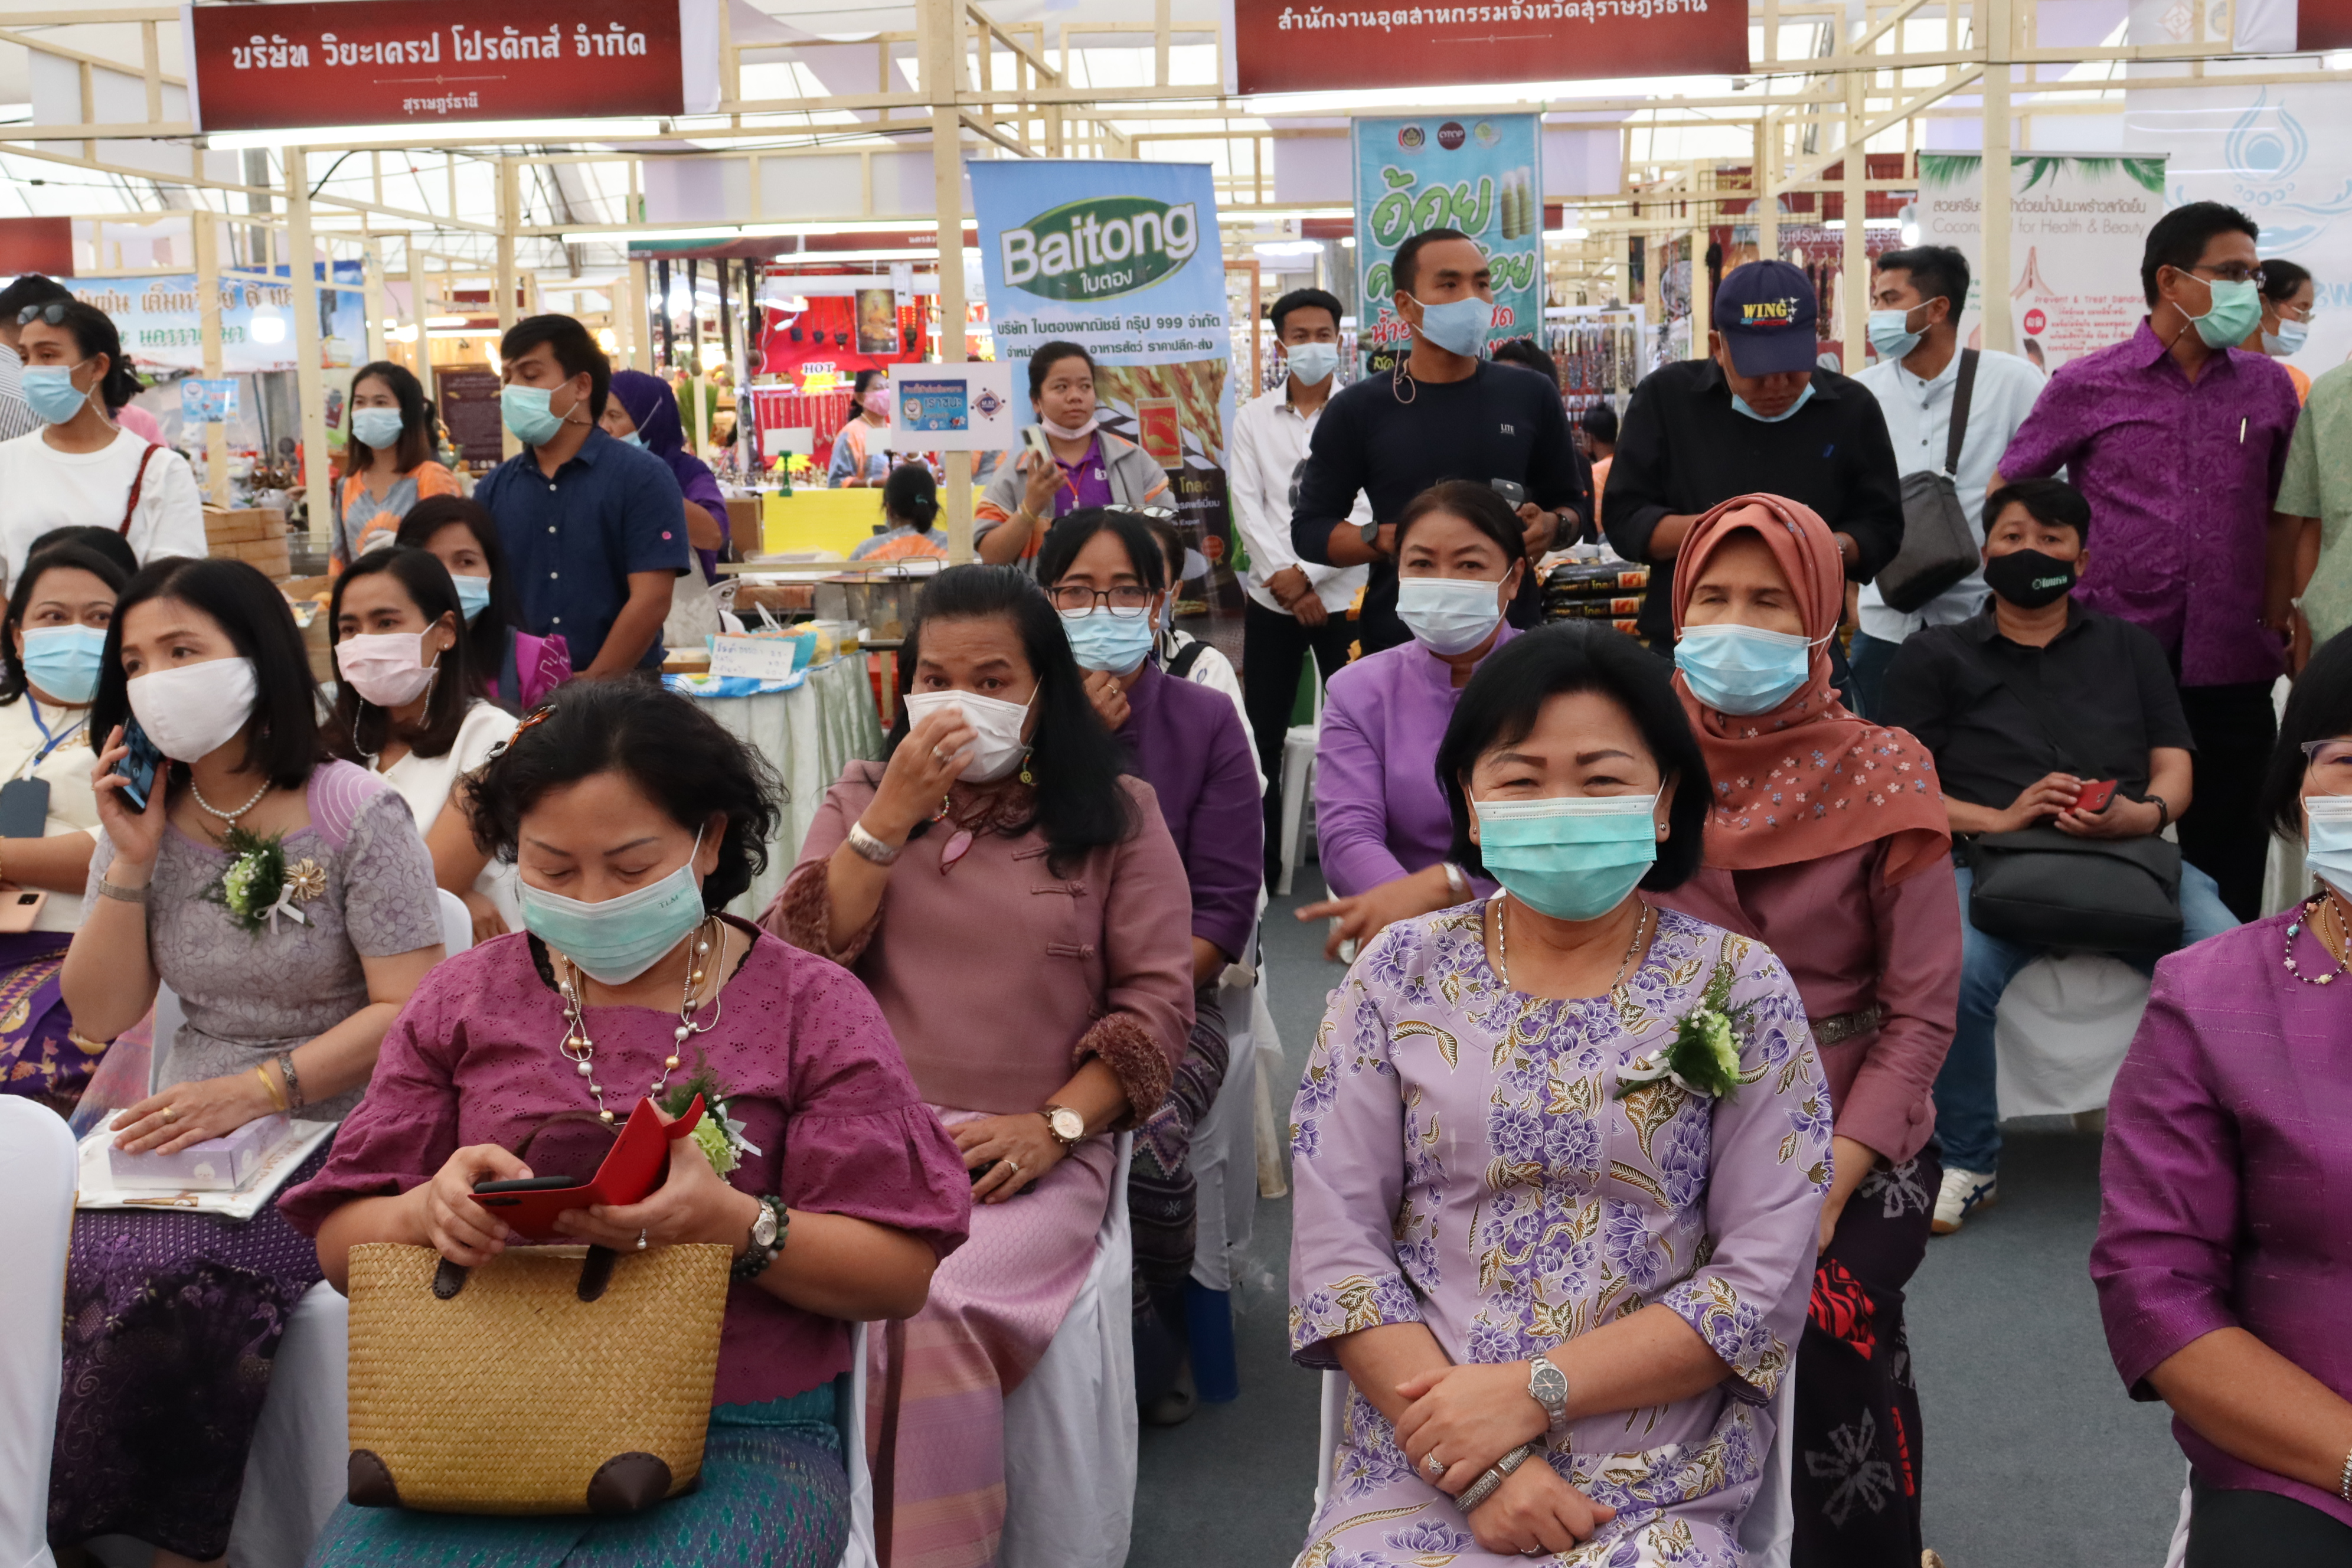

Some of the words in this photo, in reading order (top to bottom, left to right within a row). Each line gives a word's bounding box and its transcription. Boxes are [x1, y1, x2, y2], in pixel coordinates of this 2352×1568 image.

[232, 34, 309, 69] บริษัท
[451, 23, 561, 61] โปรดักส์
[573, 22, 647, 57] จำกัด
[1371, 167, 1492, 248] อ้อย
[2018, 217, 2036, 234] for
[2040, 217, 2082, 234] Health
[2087, 218, 2098, 234] &
[2103, 218, 2146, 237] Beauty
[1000, 203, 1198, 286] Baitong
[1080, 269, 1133, 293] ใบตอง
[1742, 303, 1787, 318] WING
[997, 320, 1028, 336] บริษัท
[1031, 316, 1121, 334] ใบตองพาณิชย์
[1156, 317, 1182, 328] 999
[1188, 313, 1221, 328] จำกัด
[1090, 340, 1143, 354] อาหารสัตว์
[805, 362, 834, 374] HOT
[925, 397, 962, 409] เราชนะ
